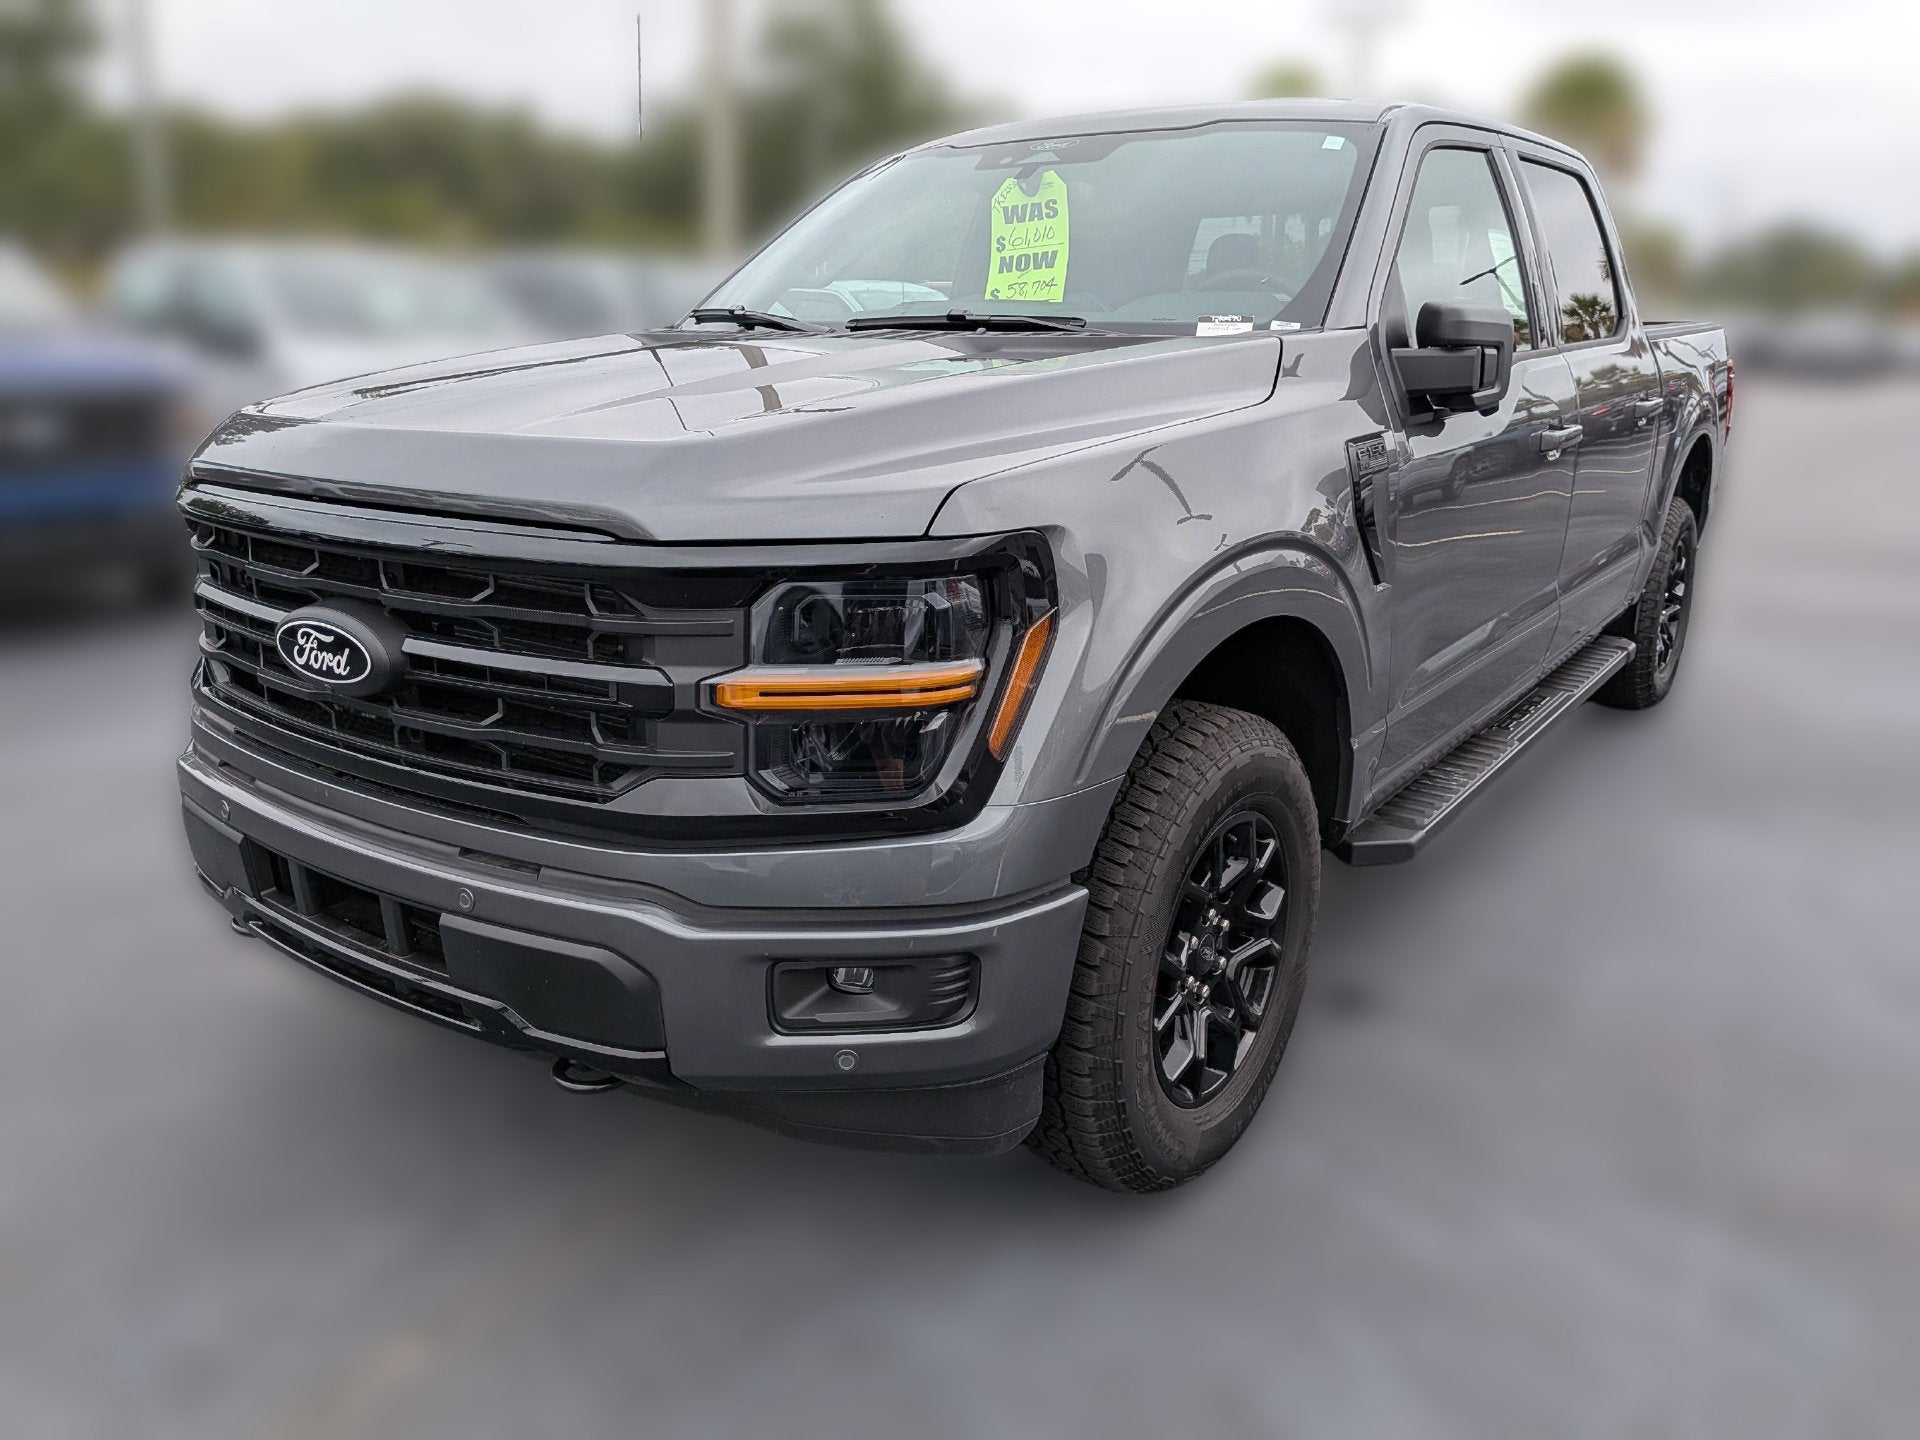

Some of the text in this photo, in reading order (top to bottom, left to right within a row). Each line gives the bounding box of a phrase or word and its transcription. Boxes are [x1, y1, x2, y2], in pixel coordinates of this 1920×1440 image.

[1002, 198, 1059, 225] WAS
[996, 226, 1056, 254] $ 61,010
[998, 250, 1059, 274] NOW
[1006, 277, 1058, 299] 58,704
[293, 627, 351, 677] Ford
